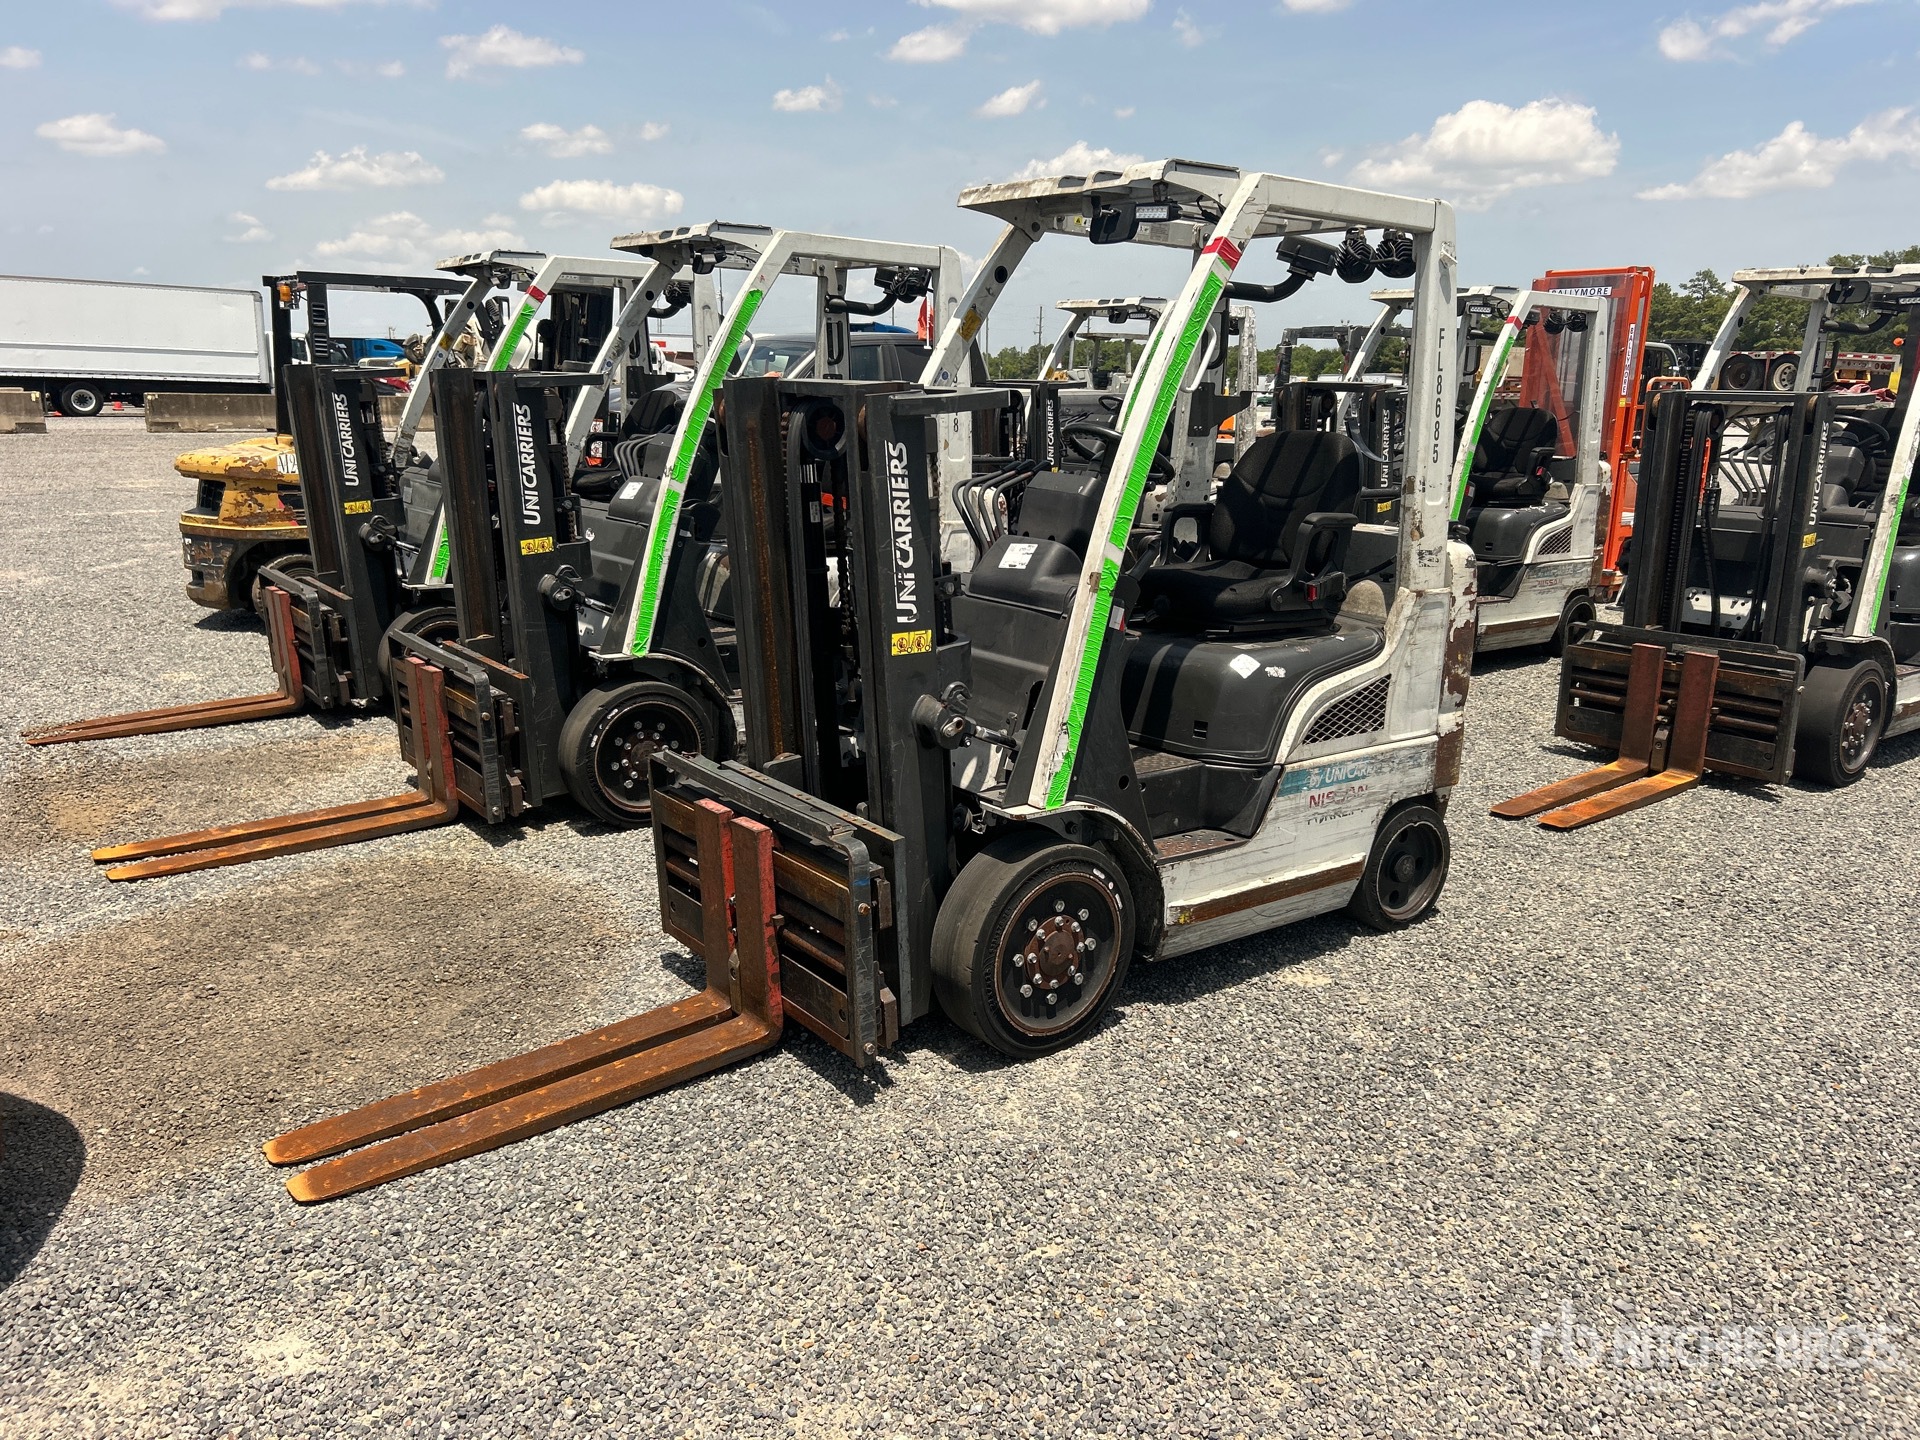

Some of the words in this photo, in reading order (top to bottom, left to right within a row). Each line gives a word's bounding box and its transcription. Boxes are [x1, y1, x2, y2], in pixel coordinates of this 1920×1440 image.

[332, 392, 358, 486] UNICARRIERS
[1432, 328, 1445, 463] FL8685
[513, 402, 541, 525] UNICARRIERS
[1808, 420, 1830, 526] UNICARRIERS
[884, 440, 919, 624] UNICARRIERS
